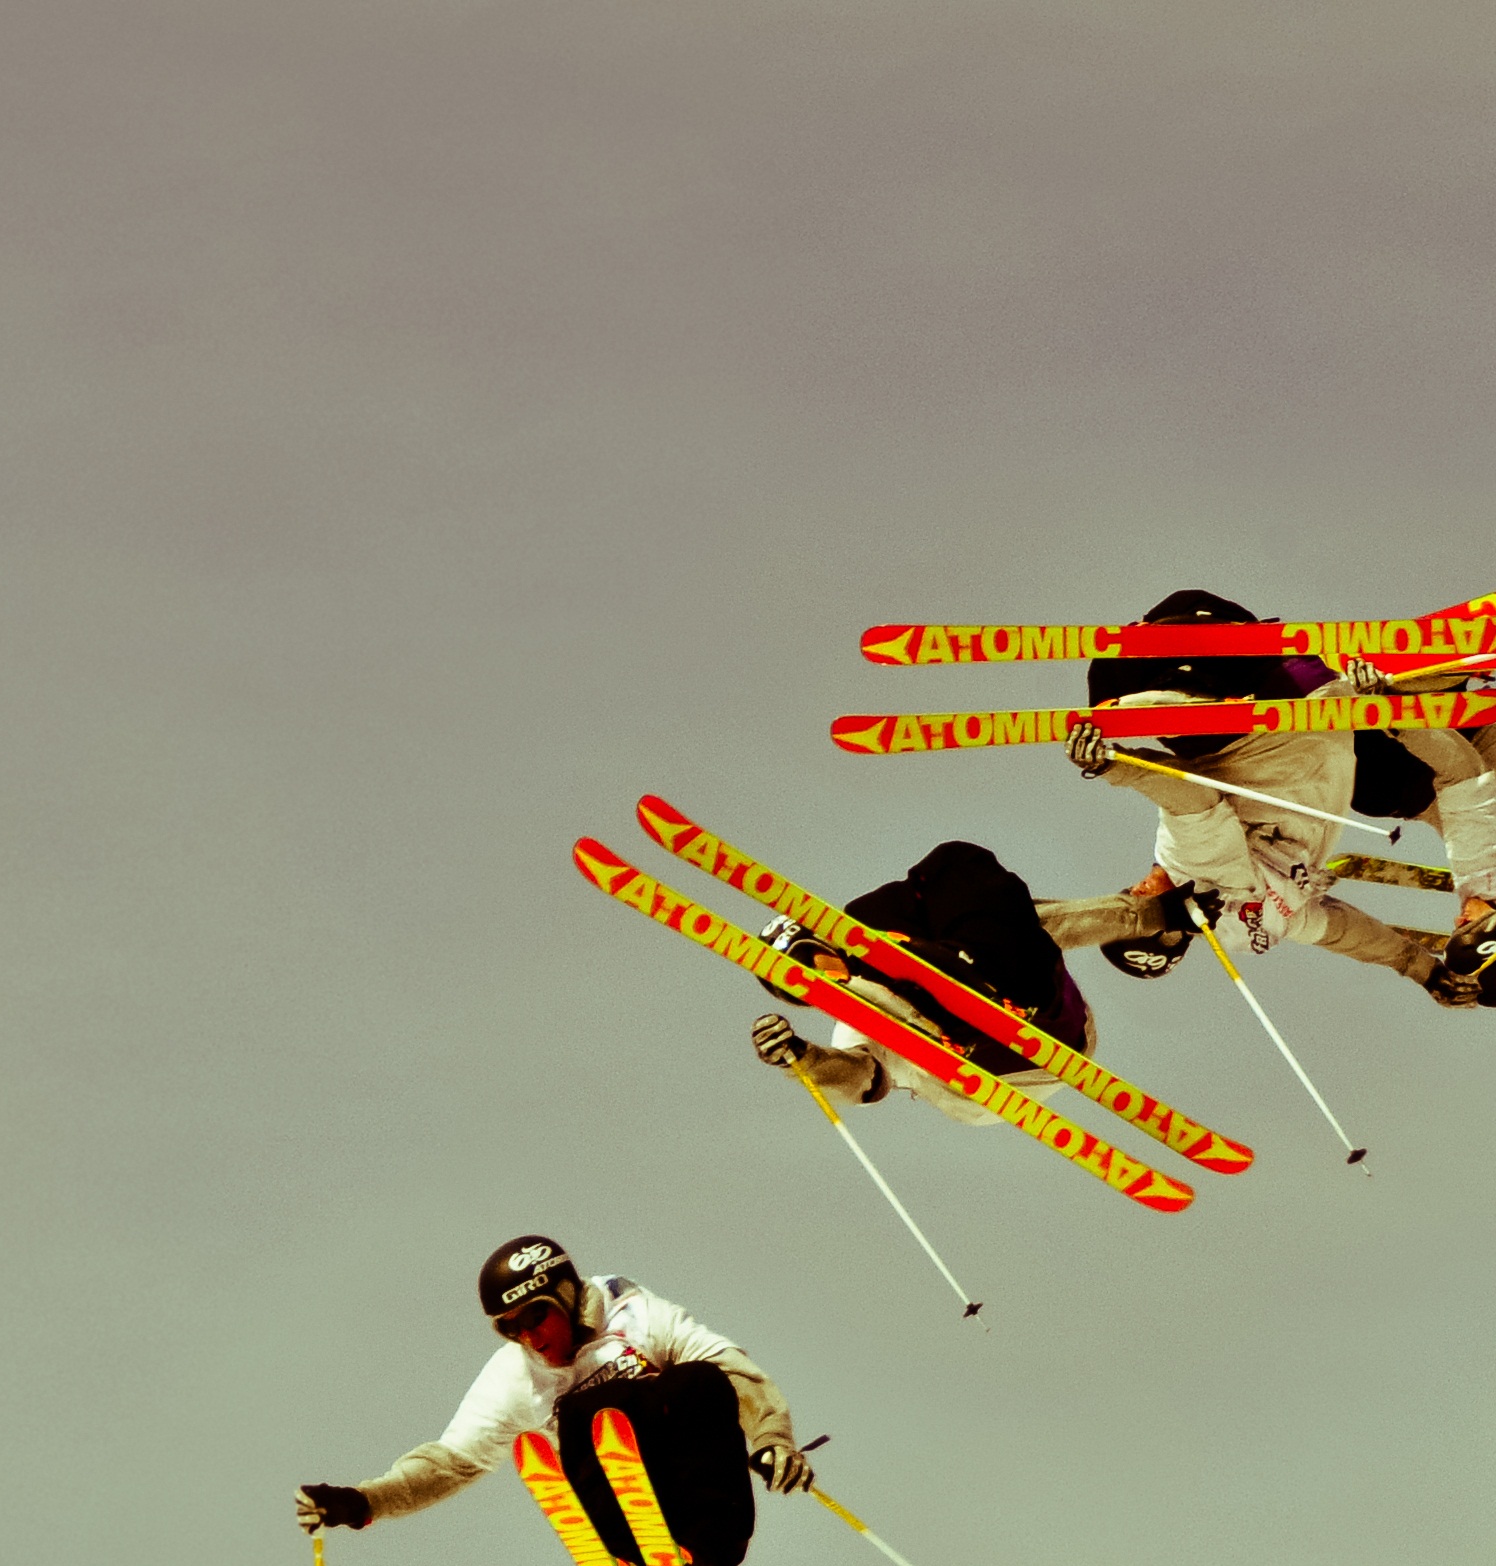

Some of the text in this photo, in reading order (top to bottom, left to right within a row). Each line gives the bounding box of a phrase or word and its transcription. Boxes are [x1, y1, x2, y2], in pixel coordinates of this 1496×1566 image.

[916, 625, 1122, 664] ATOMIC
[1281, 617, 1492, 655] ATOMIC
[888, 710, 1094, 754] ATOMIC
[1252, 690, 1461, 733] ATOMIC
[678, 829, 877, 958] ATOMIC
[613, 872, 817, 999] ATOMIC
[1009, 1024, 1206, 1156] ATOMIC
[950, 1062, 1148, 1193] ATOMIC
[501, 1273, 549, 1304] GIRO
